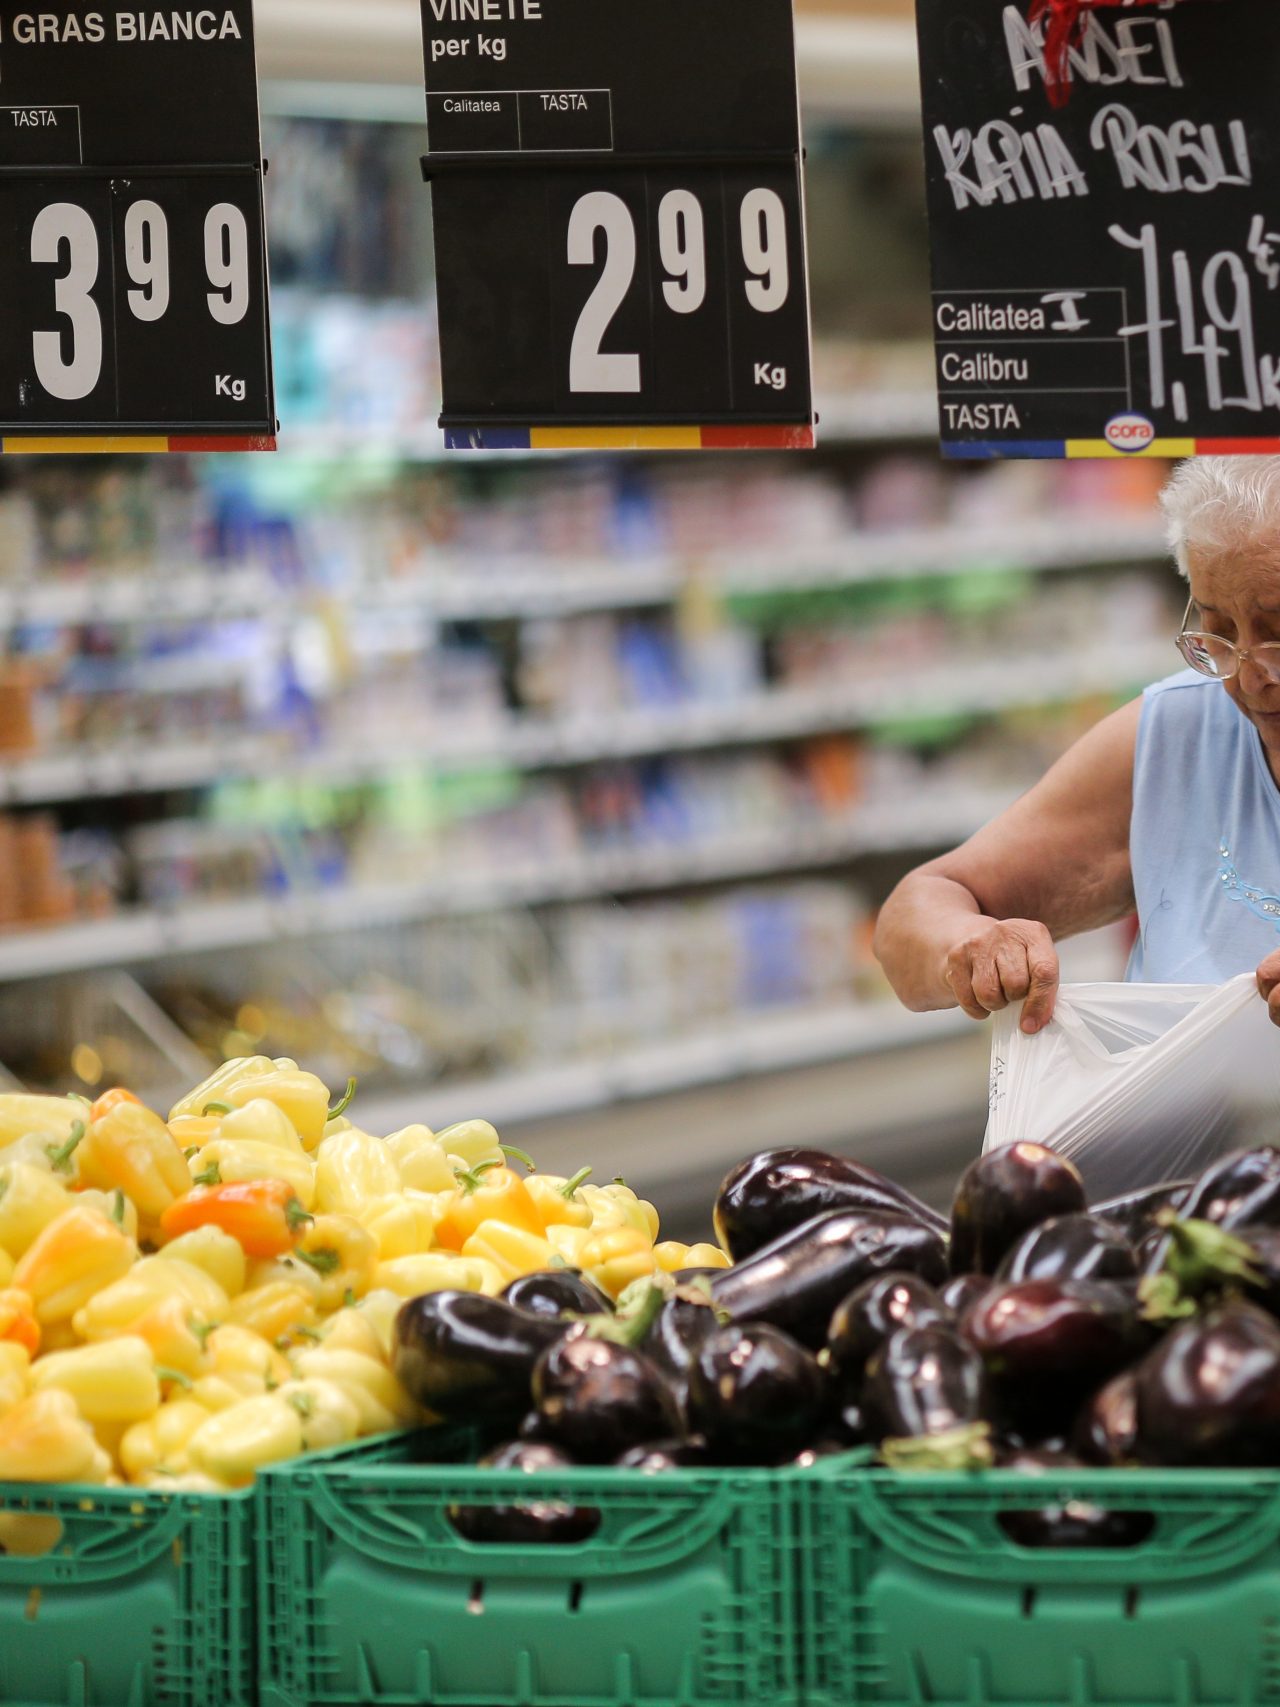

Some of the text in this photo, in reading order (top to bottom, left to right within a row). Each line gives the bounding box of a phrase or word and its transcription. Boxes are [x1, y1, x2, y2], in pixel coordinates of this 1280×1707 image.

[12, 10, 242, 44] GRAS BIANCA
[431, 34, 508, 62] per kg
[443, 99, 501, 113] Calitatea
[540, 94, 588, 111] TASTA
[11, 110, 58, 127] TASTA
[1090, 103, 1252, 193] ROSU
[936, 302, 1045, 331] Calitatea
[754, 362, 787, 391] Kg
[941, 352, 1029, 381] Calibru
[215, 374, 246, 401] Kg
[943, 403, 1021, 430] TASTA
[1108, 424, 1151, 438] cora
